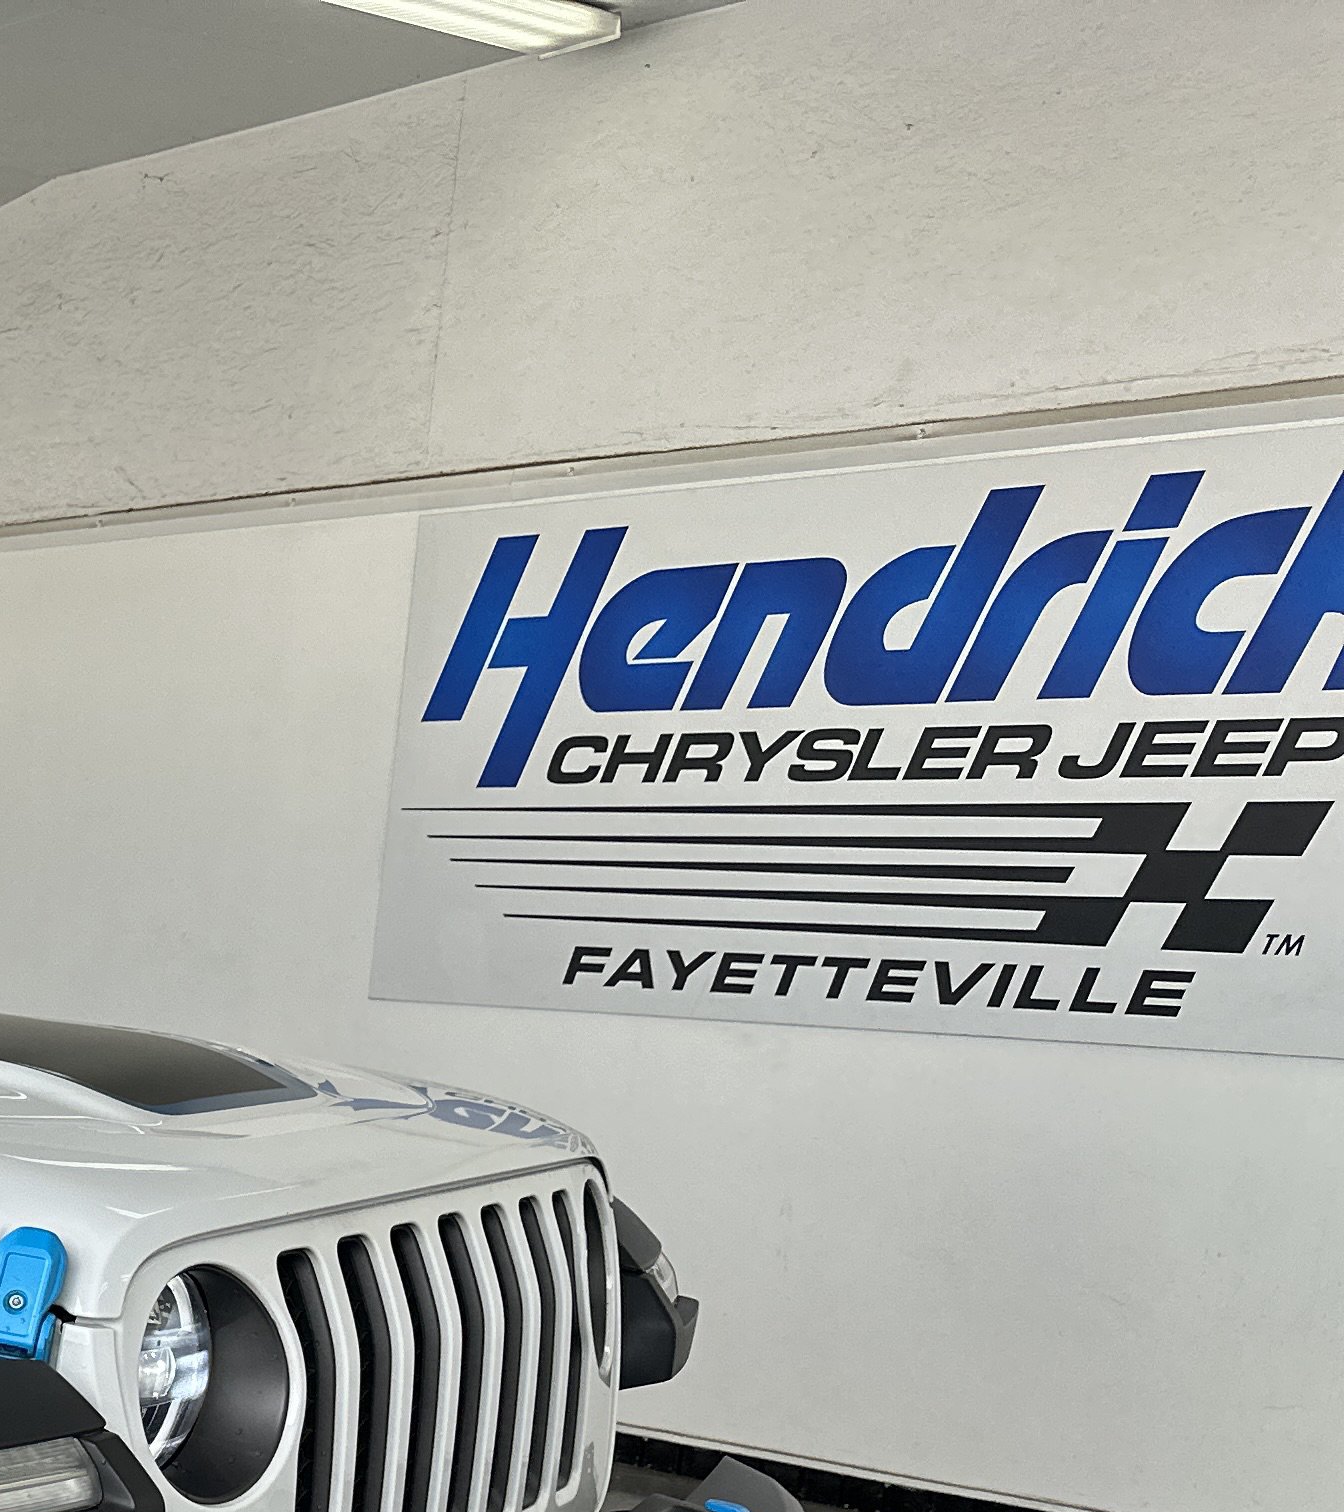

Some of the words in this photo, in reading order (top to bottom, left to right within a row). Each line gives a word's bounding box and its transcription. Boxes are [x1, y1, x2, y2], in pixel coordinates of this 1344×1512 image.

[546, 723, 1053, 785] CHRYSLER
[1057, 716, 1344, 780] JEEP
[1264, 933, 1305, 957] TM
[563, 946, 1196, 1018] FAYETTEVILLE
